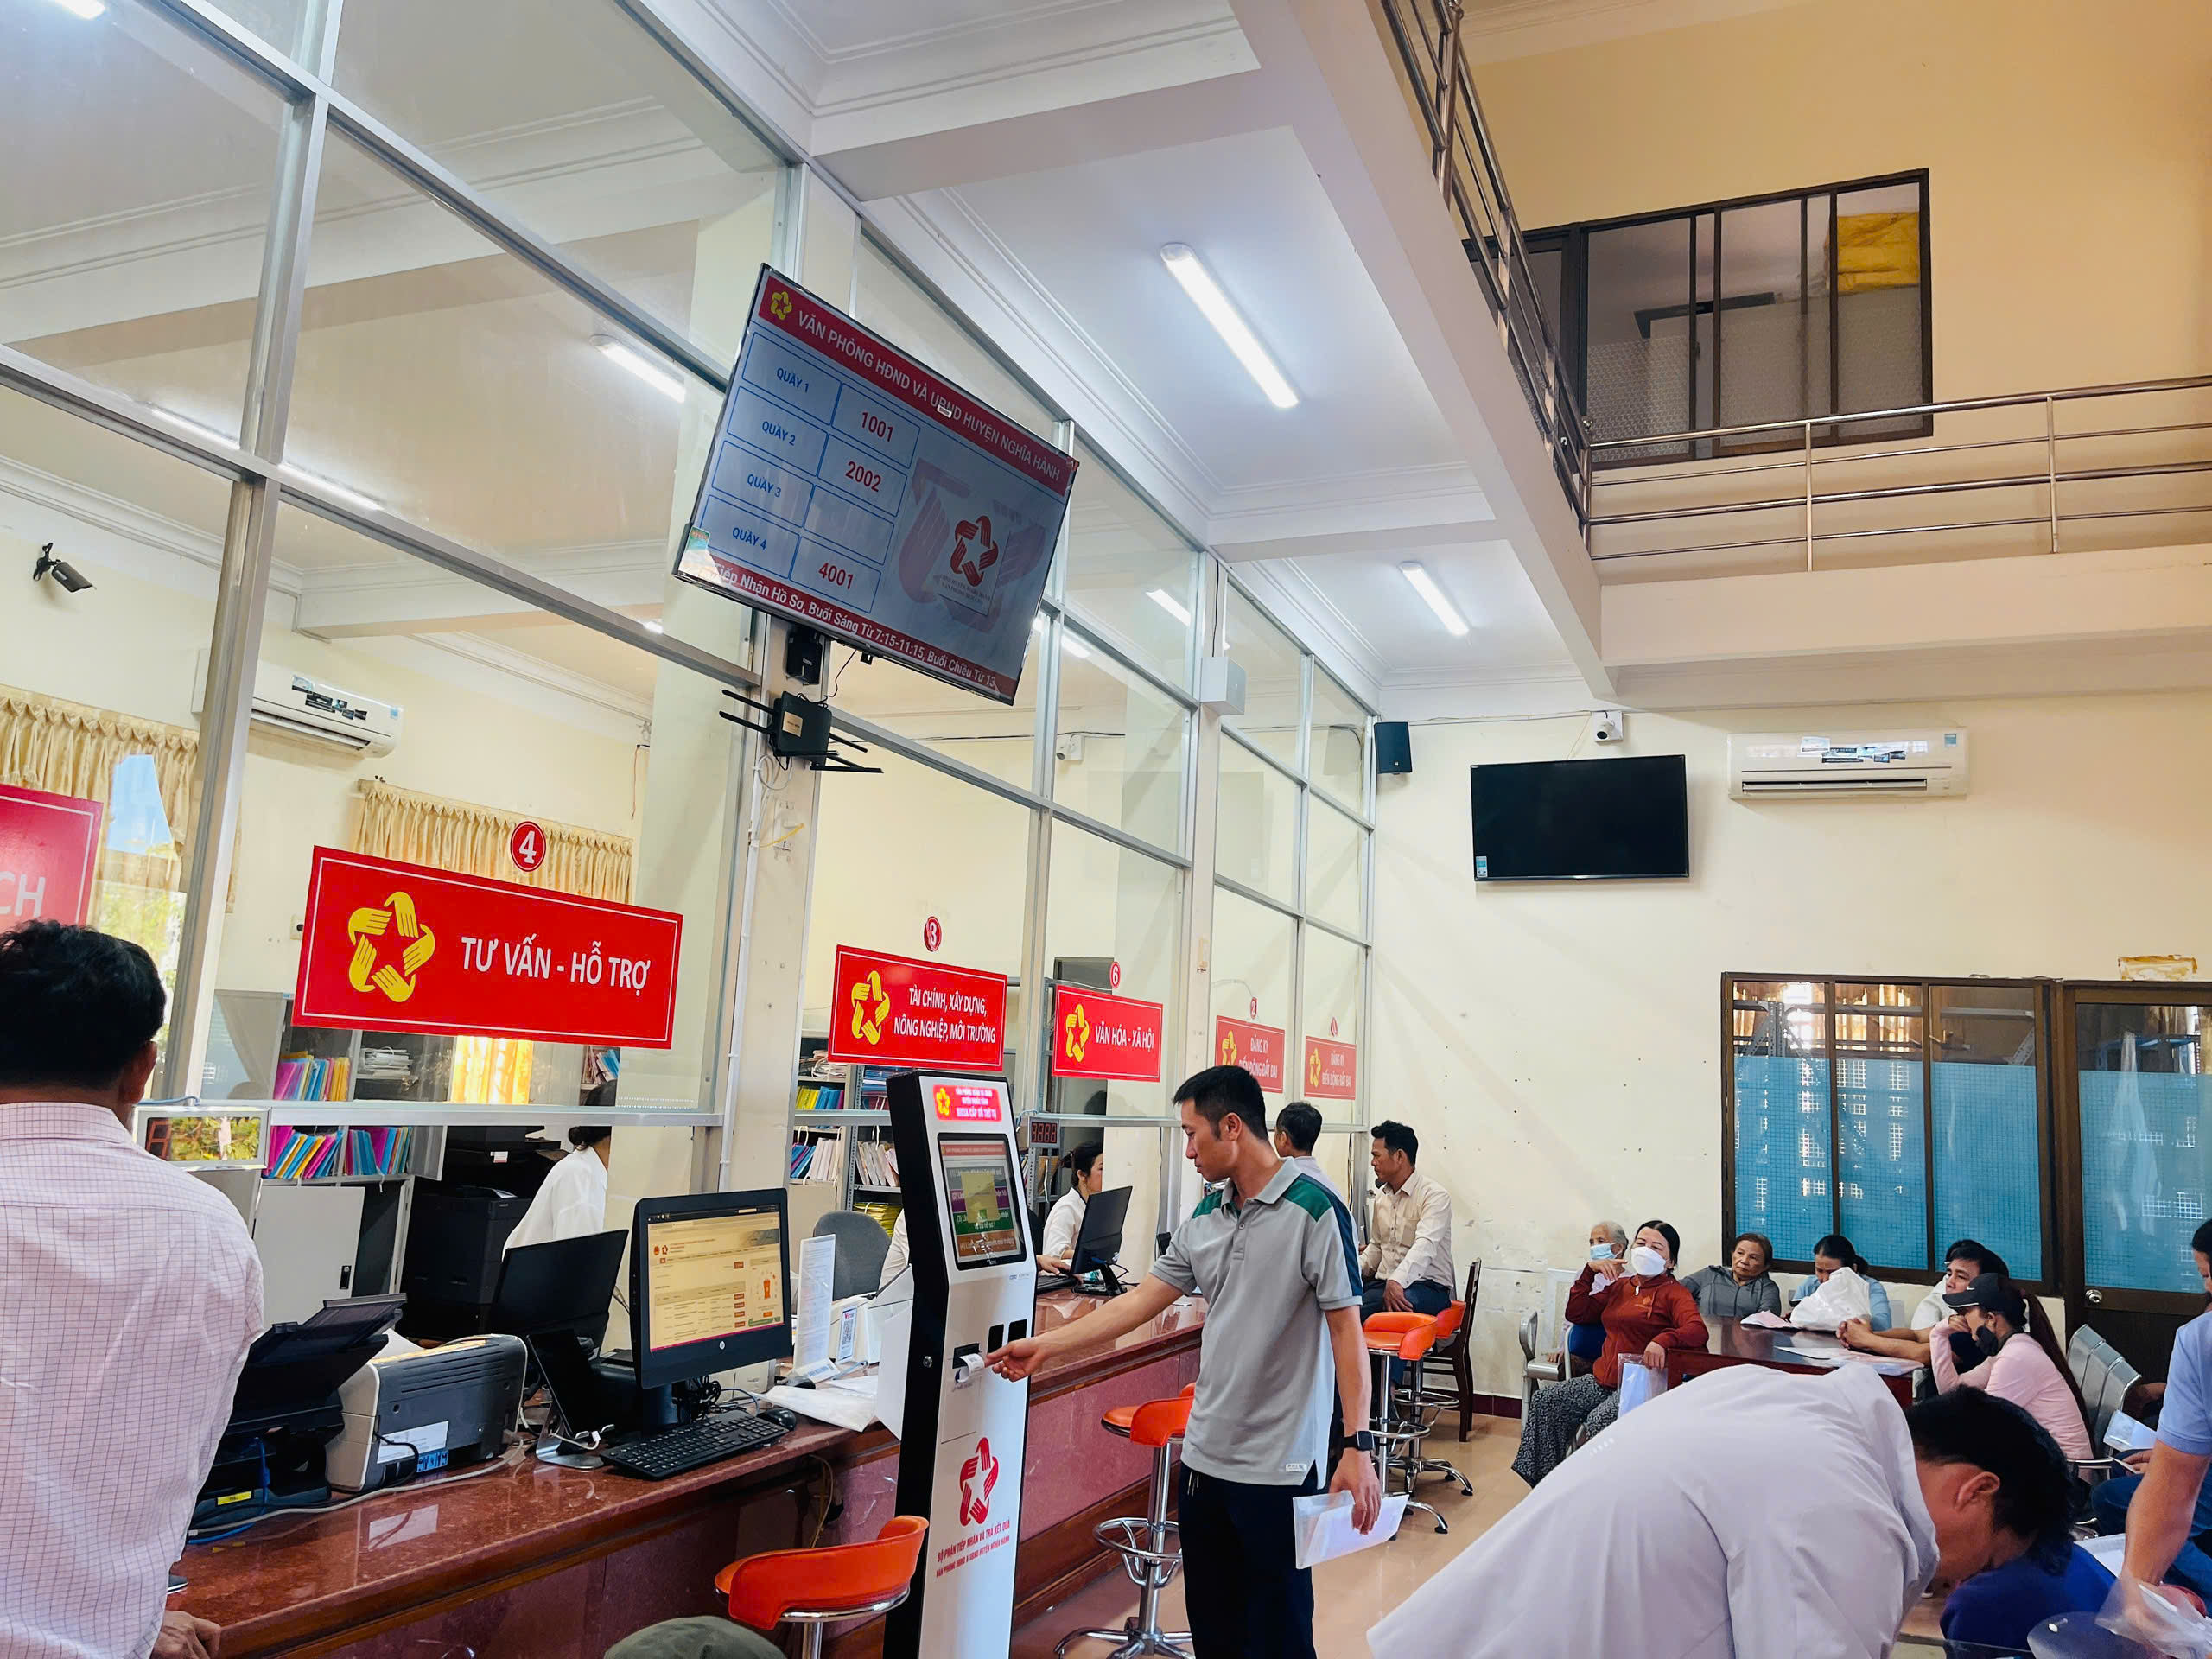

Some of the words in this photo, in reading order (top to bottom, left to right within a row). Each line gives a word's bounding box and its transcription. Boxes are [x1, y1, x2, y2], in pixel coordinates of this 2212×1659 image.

[798, 310, 826, 340] VĂN
[827, 330, 874, 368] PHÒNG
[875, 359, 911, 389] HĐND
[912, 381, 928, 402] VÀ
[963, 412, 1000, 444] HUYỆN
[1001, 435, 1032, 465] NGHĨA
[1033, 454, 1060, 481] HÀNH
[804, 383, 810, 393] 1
[788, 435, 796, 446] 2
[861, 411, 894, 442] 1001
[773, 486, 781, 498] 3
[845, 461, 881, 493] 2002
[760, 539, 767, 550] 4
[818, 562, 854, 590] 4001
[741, 574, 769, 596] Nhận
[771, 586, 787, 603] Hồ
[789, 594, 805, 613] Sơ,
[809, 601, 832, 621] Buổi
[833, 612, 859, 634] Sáng
[861, 622, 874, 639] Từ
[949, 659, 972, 678] Chiều
[974, 669, 985, 683] Từ
[518, 830, 537, 864] 4
[929, 922, 938, 946] 3
[461, 936, 499, 972] TƯ
[504, 932, 551, 980] VẤN
[570, 940, 603, 985] HỖ
[607, 957, 652, 996] TRỢ
[1112, 965, 1119, 985] 6
[909, 984, 921, 1007] TÀI
[922, 987, 948, 1013] CHÍNH,
[949, 990, 963, 1012] XÂY
[963, 995, 987, 1017] DỰNG,
[893, 1013, 918, 1036] NÔNG
[919, 1018, 949, 1042] NGHIỆP,
[950, 1020, 965, 1041] MÔI
[967, 1022, 996, 1044] TRƯỜNG
[1095, 1021, 1110, 1045] VĂN
[1111, 1024, 1127, 1046] HÓA
[1142, 1027, 1155, 1052] HỘI
